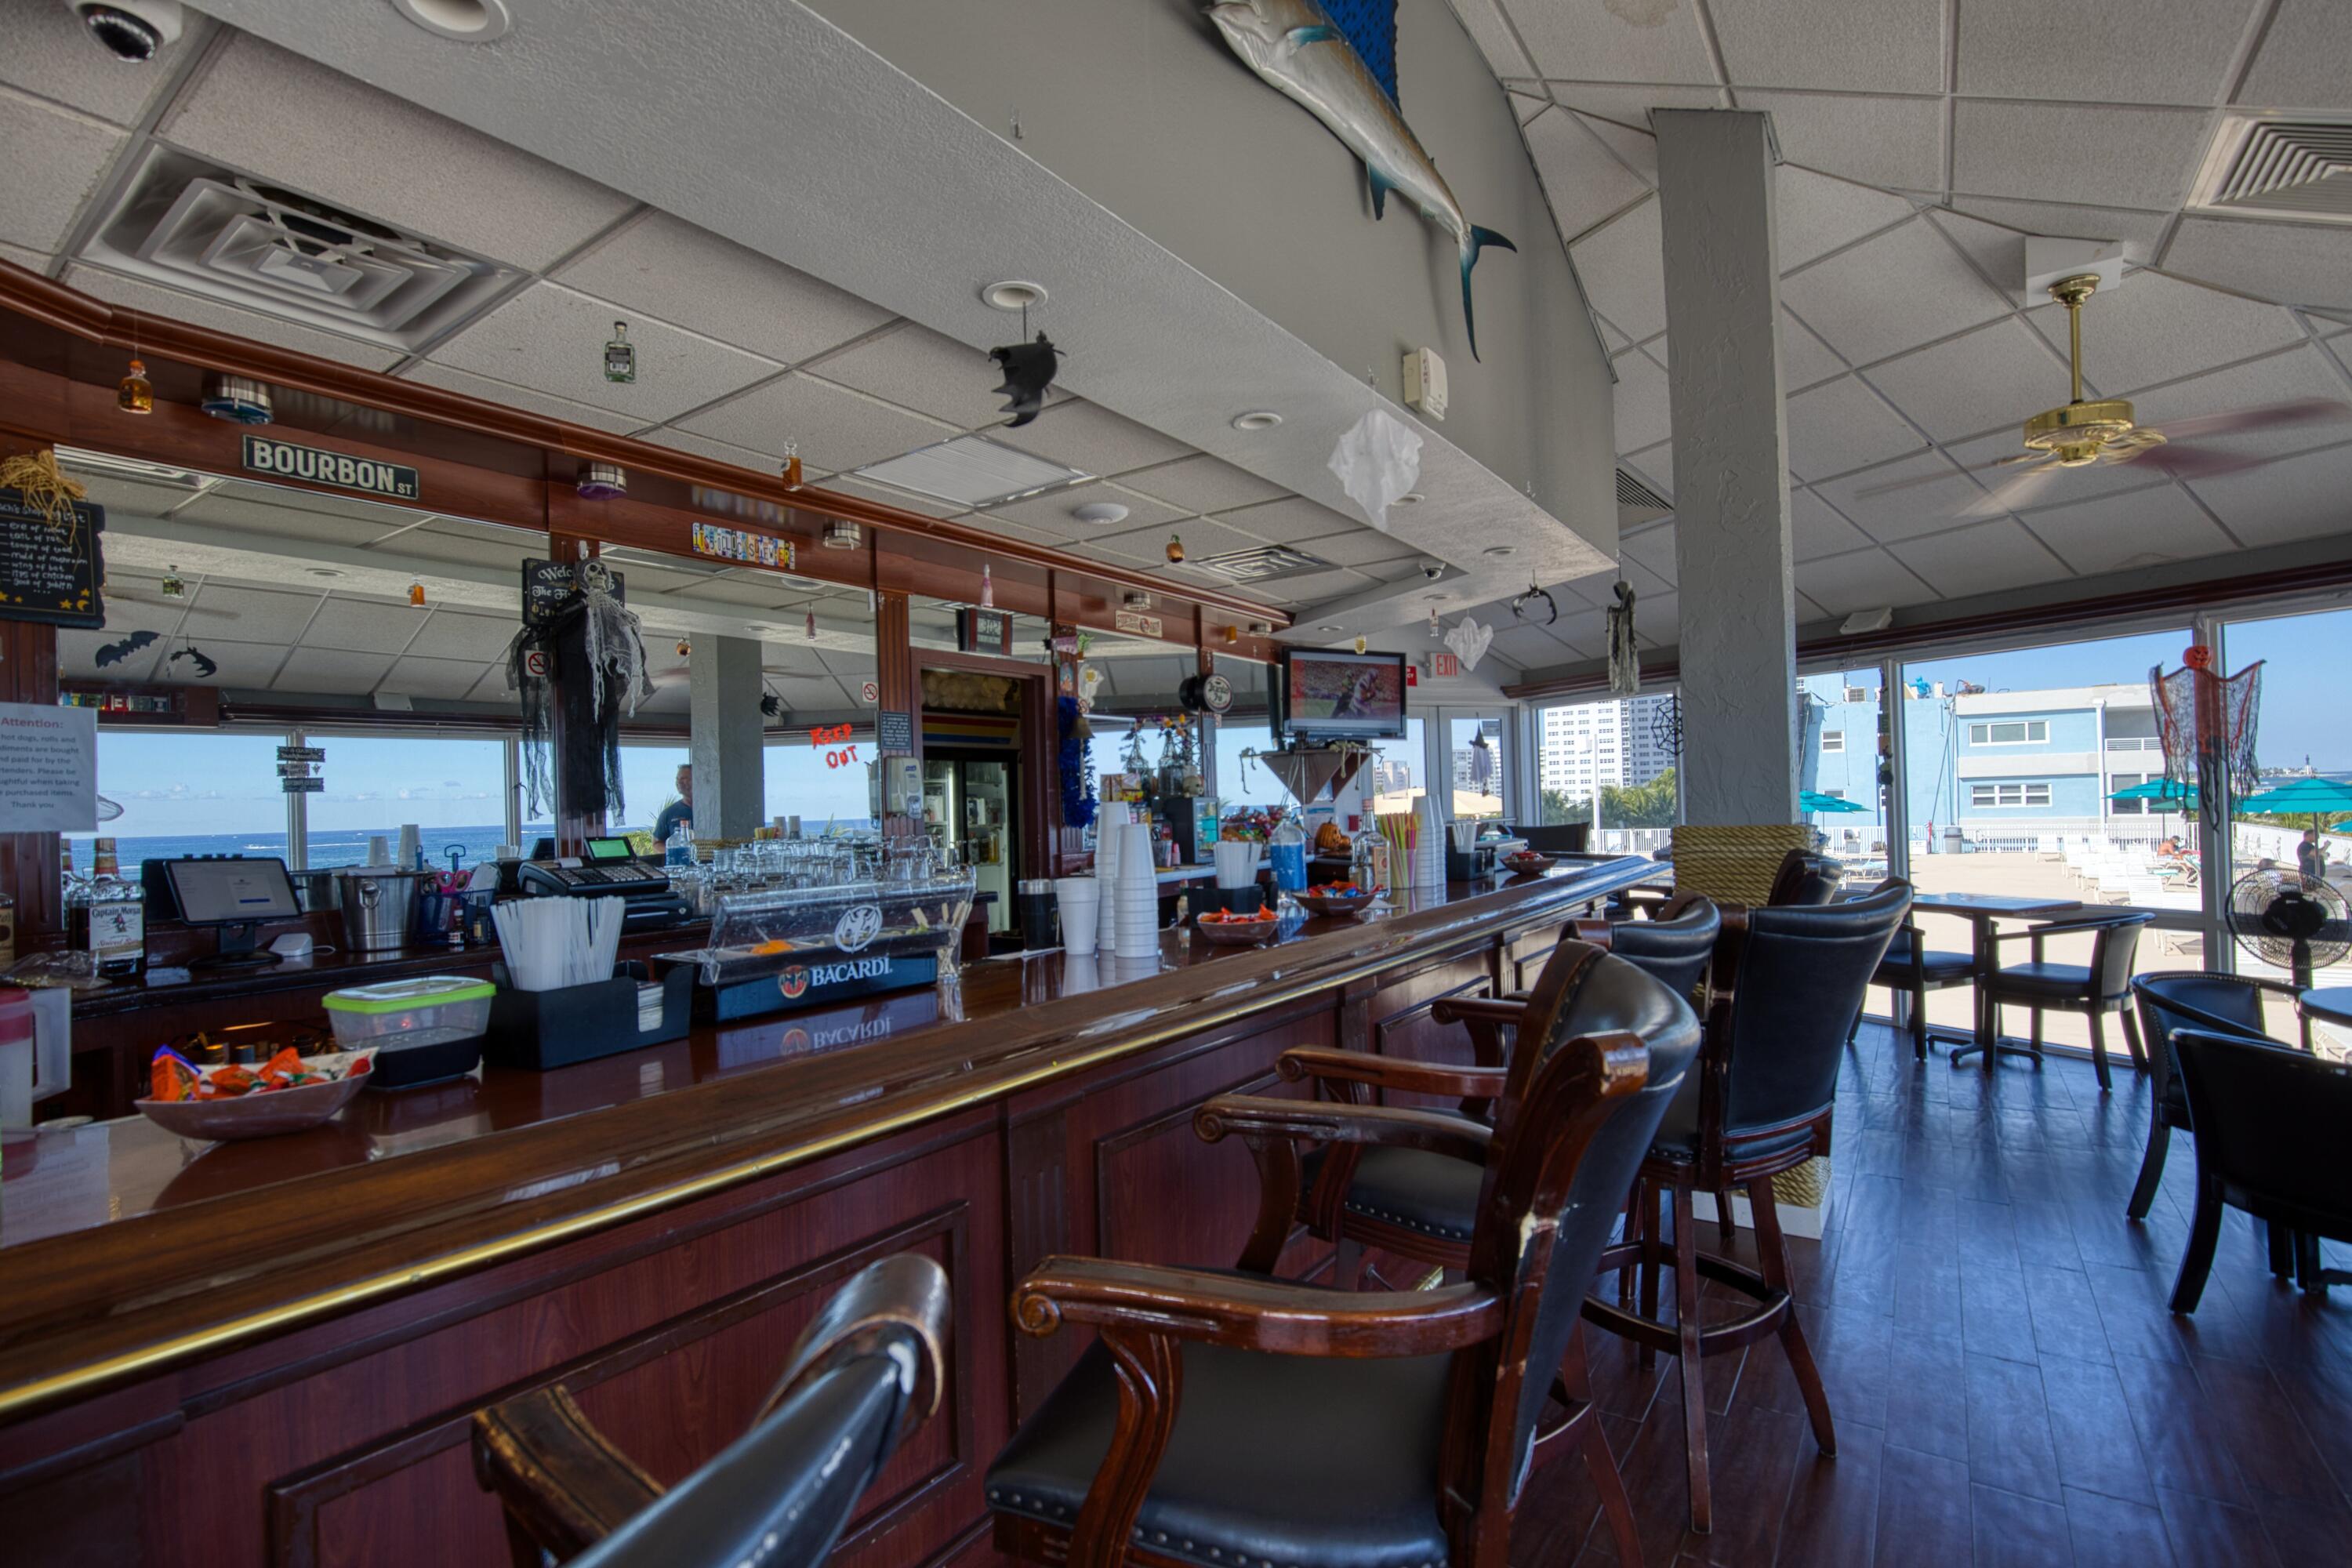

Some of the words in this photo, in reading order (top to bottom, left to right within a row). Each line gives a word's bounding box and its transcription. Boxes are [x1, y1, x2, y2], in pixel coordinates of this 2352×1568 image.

[253, 440, 394, 492] BOURBON
[397, 482, 412, 495] ST
[532, 586, 552, 597] The
[1436, 654, 1457, 677] EXIT
[1, 717, 64, 728] Attention:
[826, 745, 858, 769] OUT
[92, 907, 119, 919] Captain
